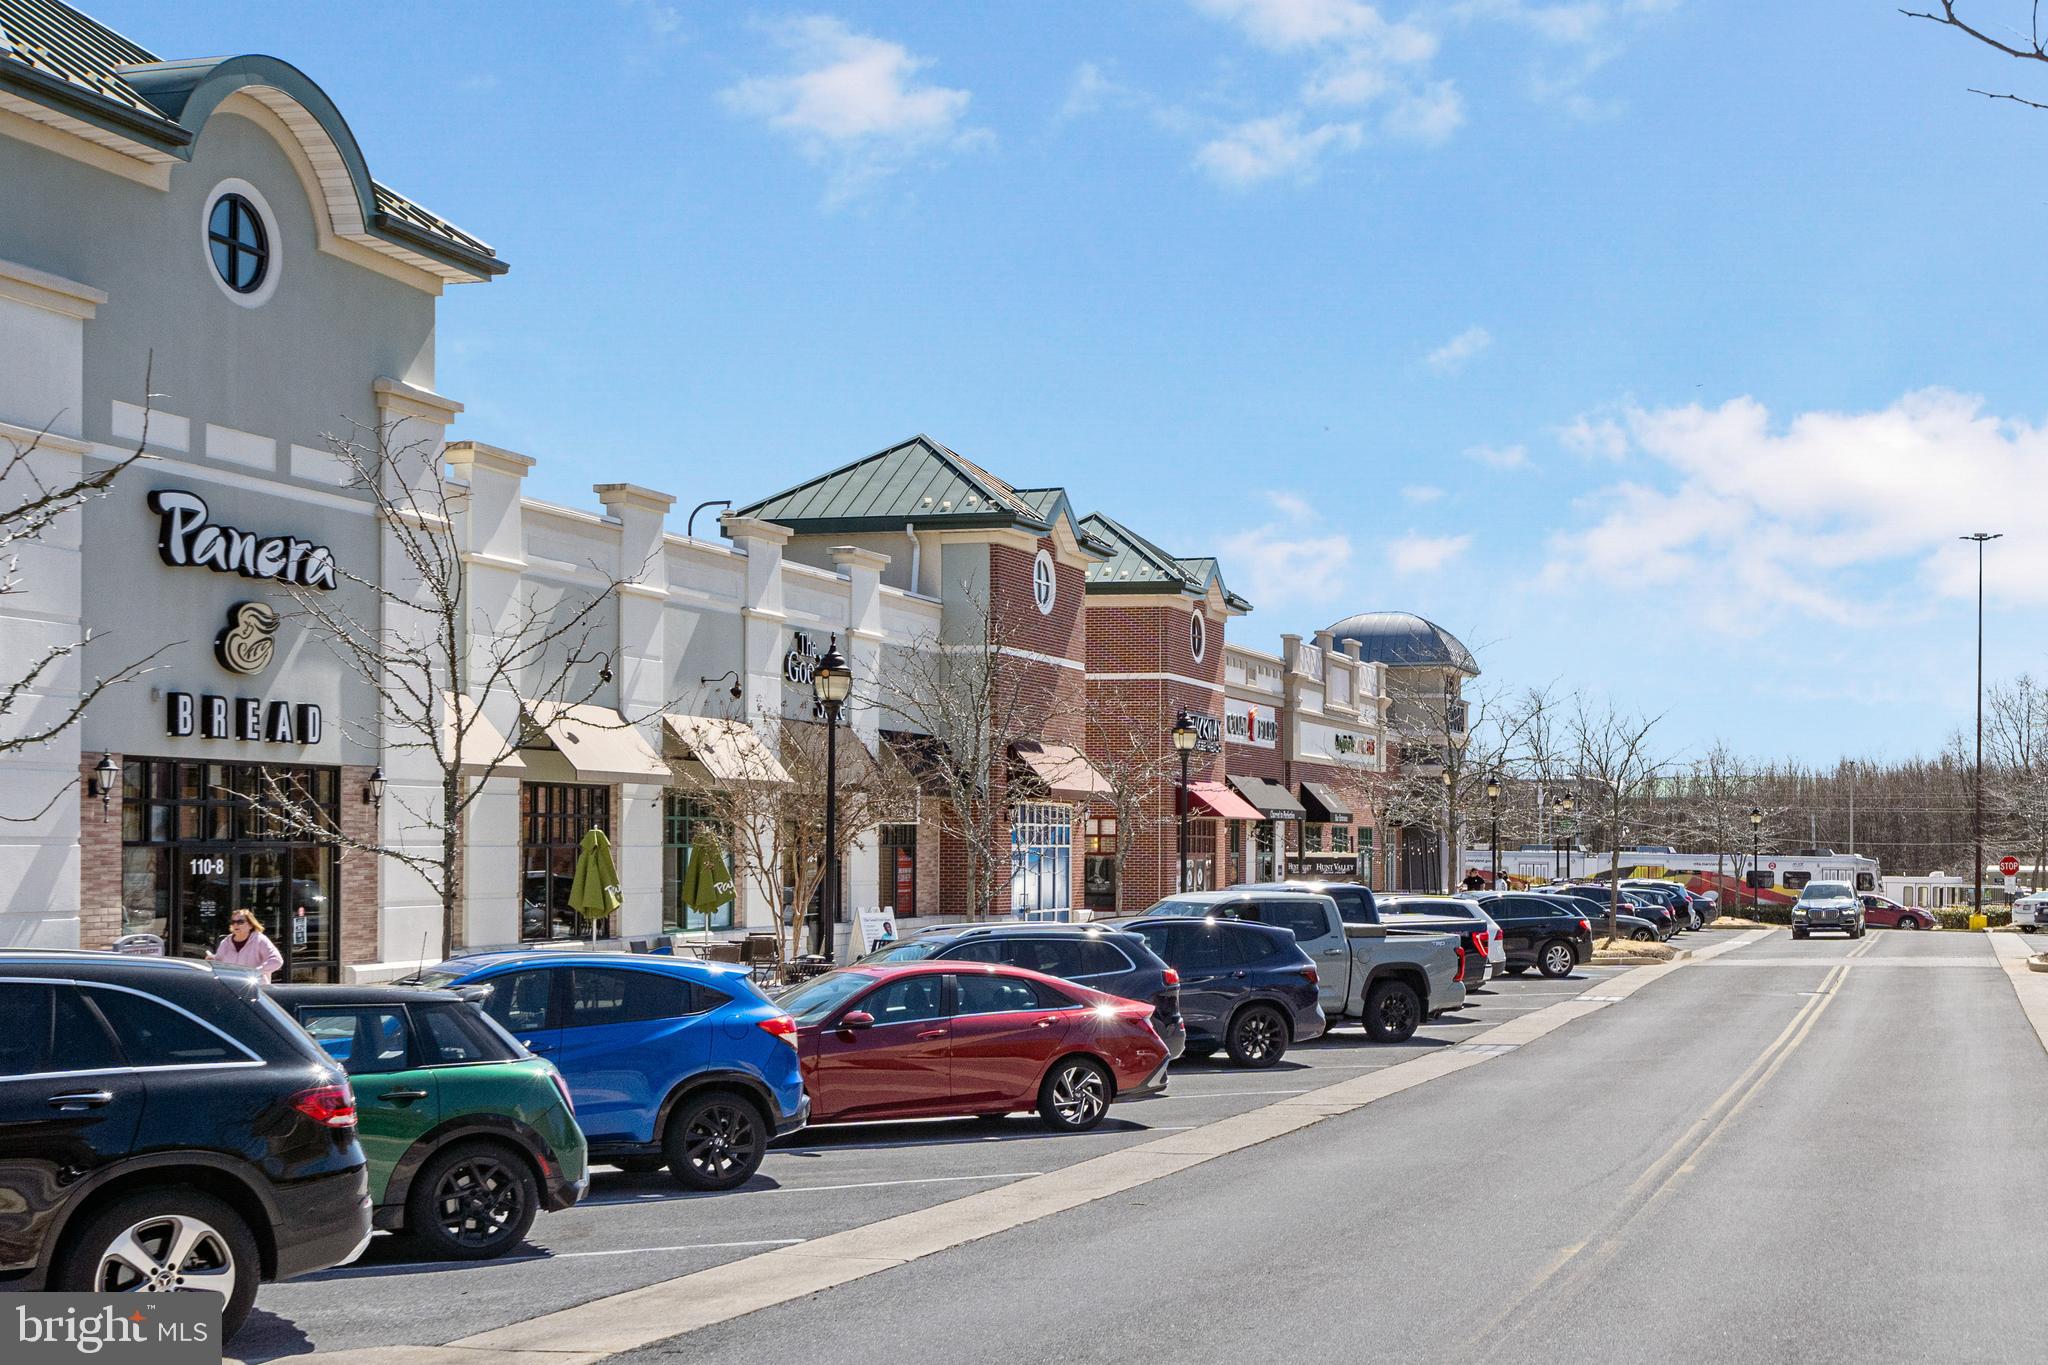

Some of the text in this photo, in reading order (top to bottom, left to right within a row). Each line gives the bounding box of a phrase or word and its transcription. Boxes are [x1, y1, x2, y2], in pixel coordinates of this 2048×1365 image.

[148, 489, 336, 589] Panera
[796, 632, 817, 657] The
[168, 692, 321, 744] BREAD
[190, 859, 224, 875] 110-8
[1316, 862, 1354, 872] HUNT VALLEY
[2000, 862, 2018, 870] STOP
